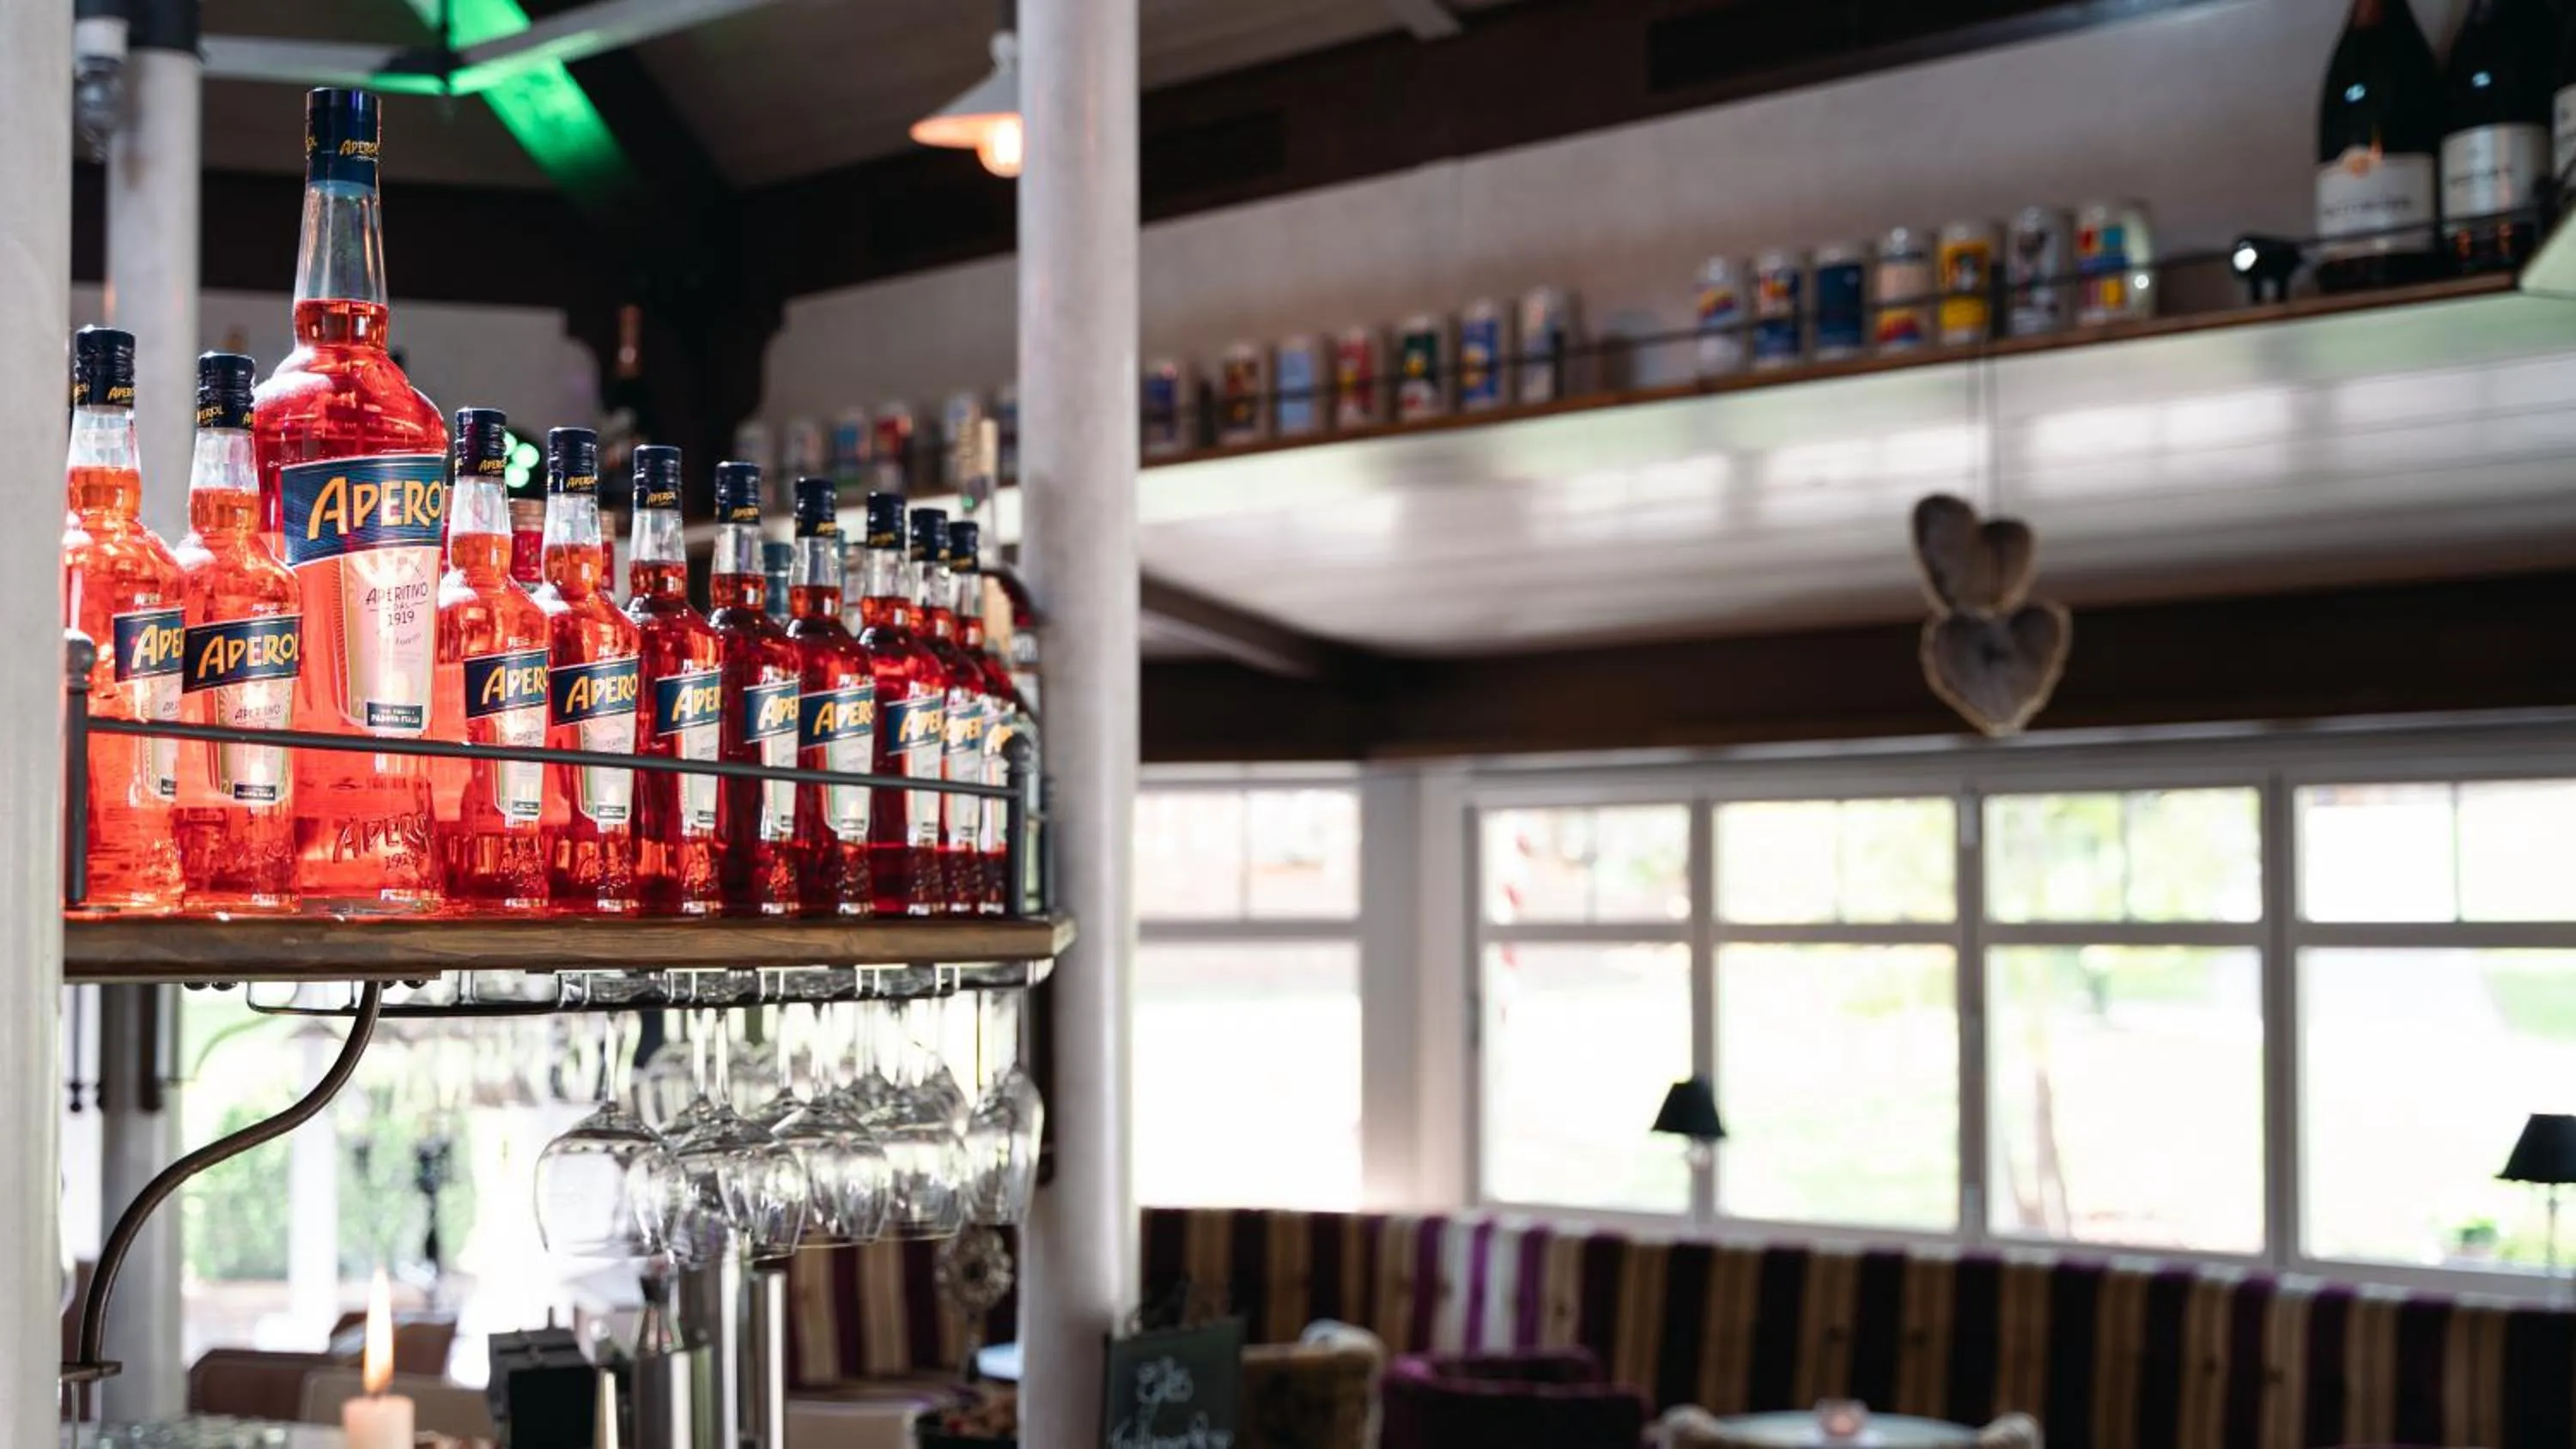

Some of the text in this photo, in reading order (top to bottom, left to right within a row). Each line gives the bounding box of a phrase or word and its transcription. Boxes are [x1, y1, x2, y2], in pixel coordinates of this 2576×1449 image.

[307, 476, 443, 541] APERO
[387, 610, 415, 626] 1919
[131, 624, 185, 670] APE
[565, 676, 639, 714] APERO
[758, 694, 799, 731] APE
